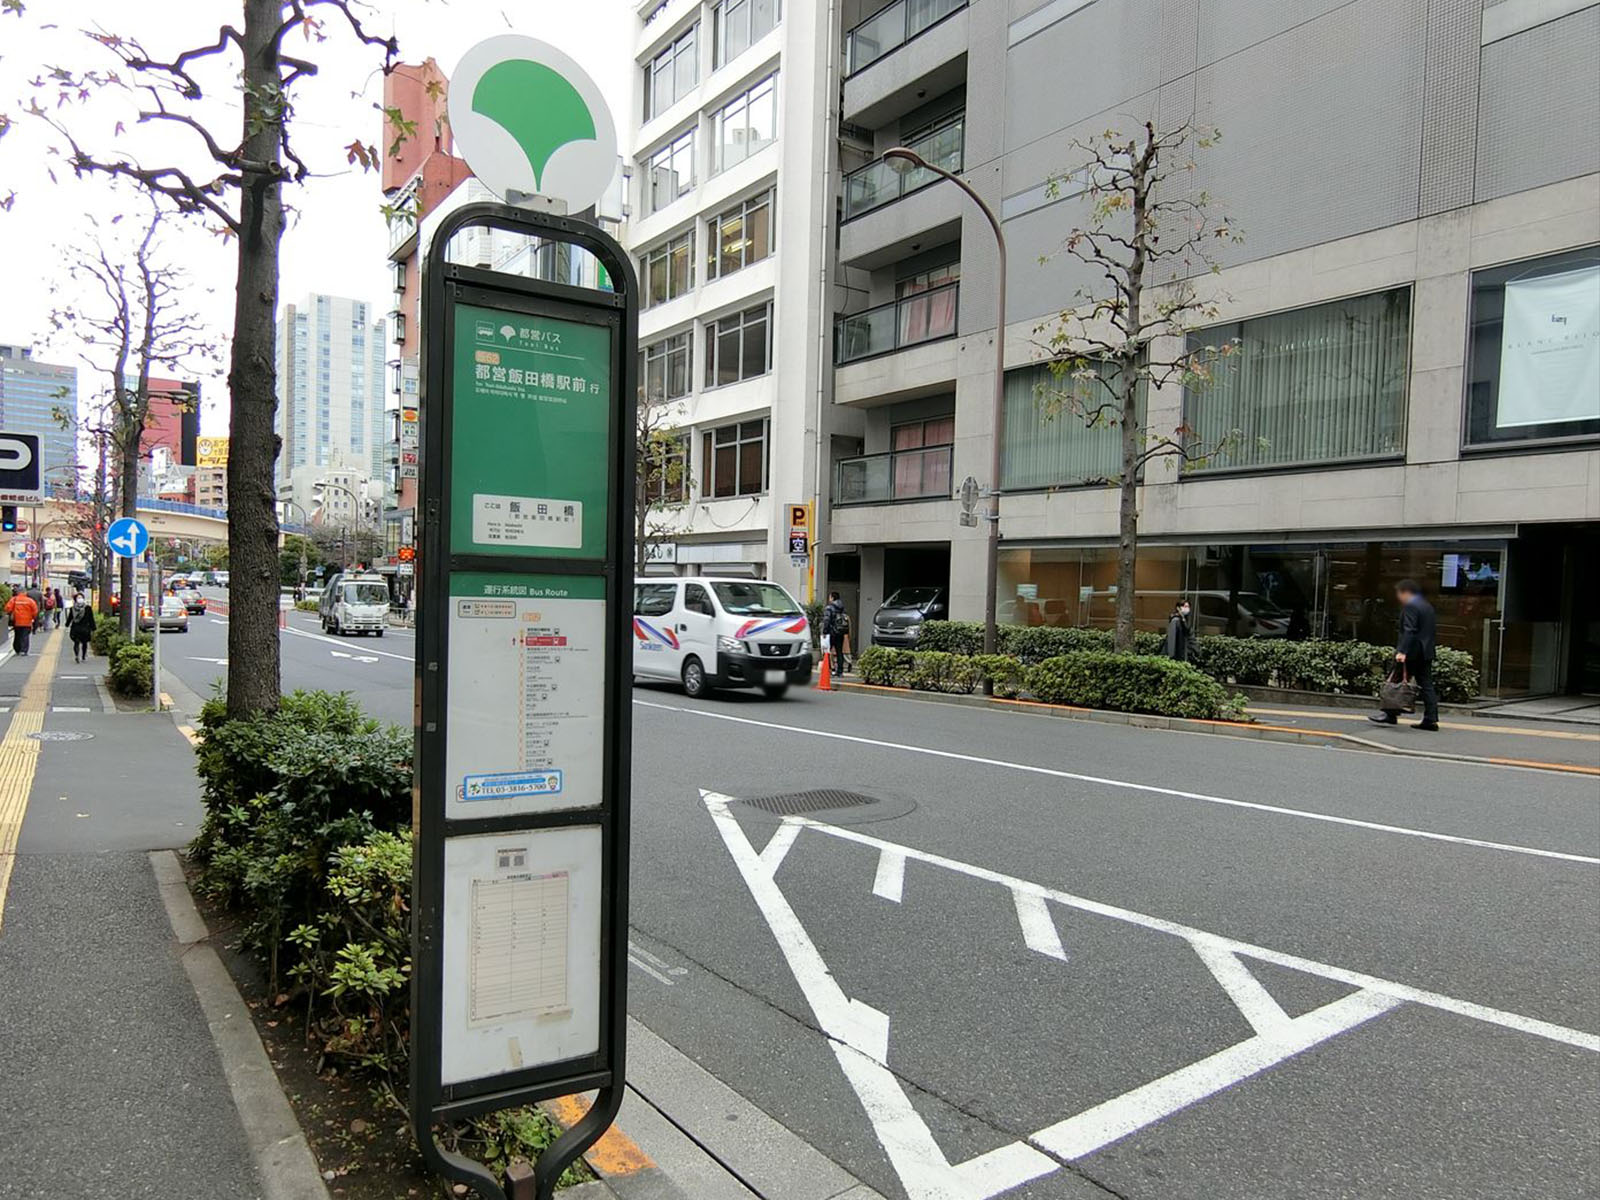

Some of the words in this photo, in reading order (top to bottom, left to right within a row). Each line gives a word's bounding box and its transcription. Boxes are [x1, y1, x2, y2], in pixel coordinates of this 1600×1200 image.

[519, 328, 561, 344] 都営バス
[475, 364, 587, 393] 都営飯田橋駅前
[590, 383, 600, 395] 行
[510, 501, 574, 517] 飯田橋
[792, 507, 805, 526] P
[792, 539, 805, 553] 空
[484, 584, 527, 596] 運行系統図
[529, 588, 543, 596] Bus
[545, 589, 569, 597] Route
